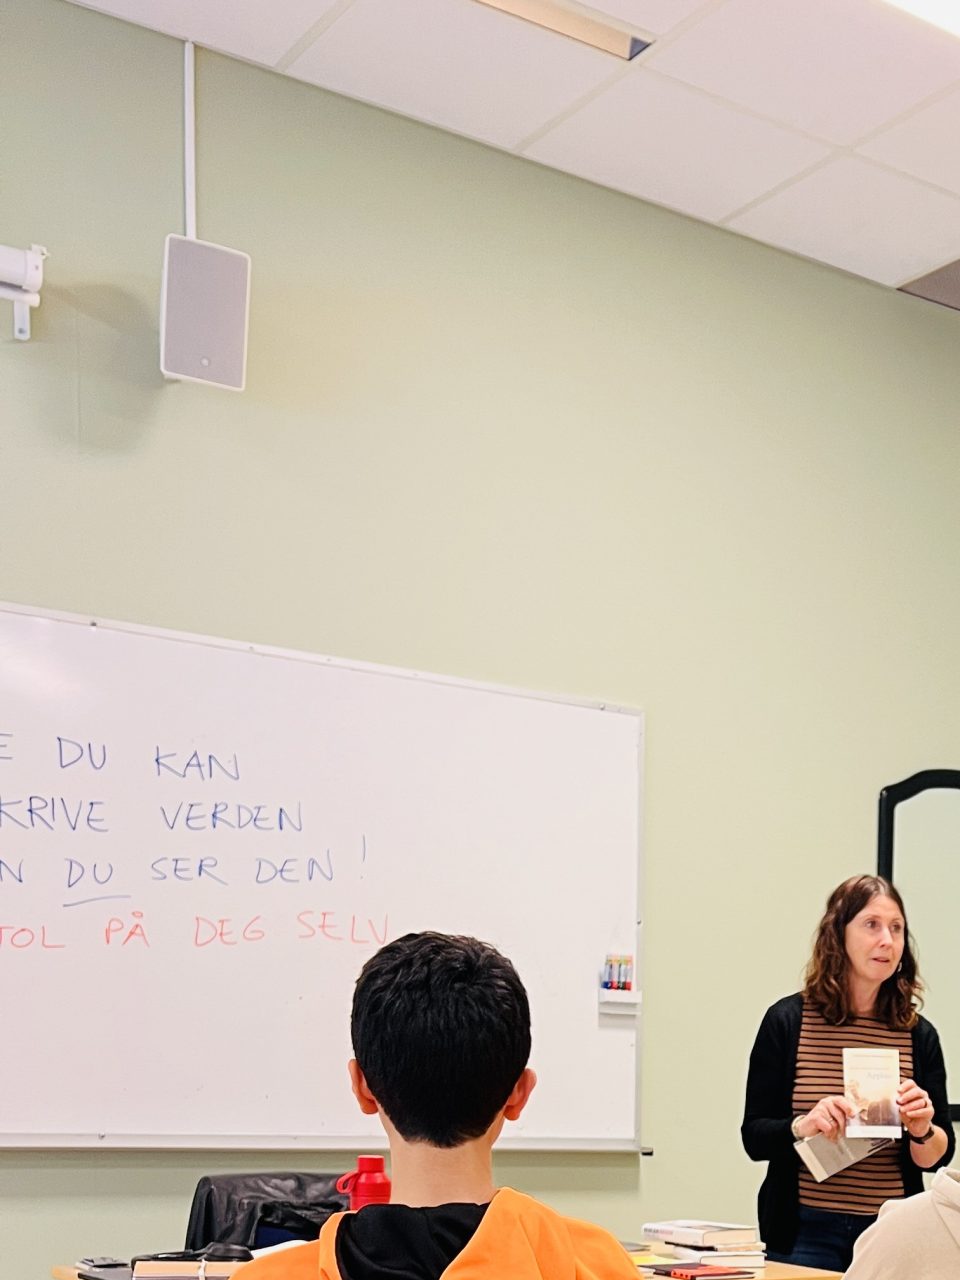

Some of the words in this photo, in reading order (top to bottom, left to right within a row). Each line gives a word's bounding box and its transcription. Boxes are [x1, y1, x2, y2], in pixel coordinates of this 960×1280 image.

[57, 736, 107, 770] DU
[155, 746, 240, 781] KAN
[159, 801, 303, 832] VERDEN
[64, 858, 114, 889] DU
[151, 856, 228, 886] SER
[104, 911, 150, 947] PÅ
[195, 916, 265, 947] DEG
[297, 910, 389, 945] SELV
